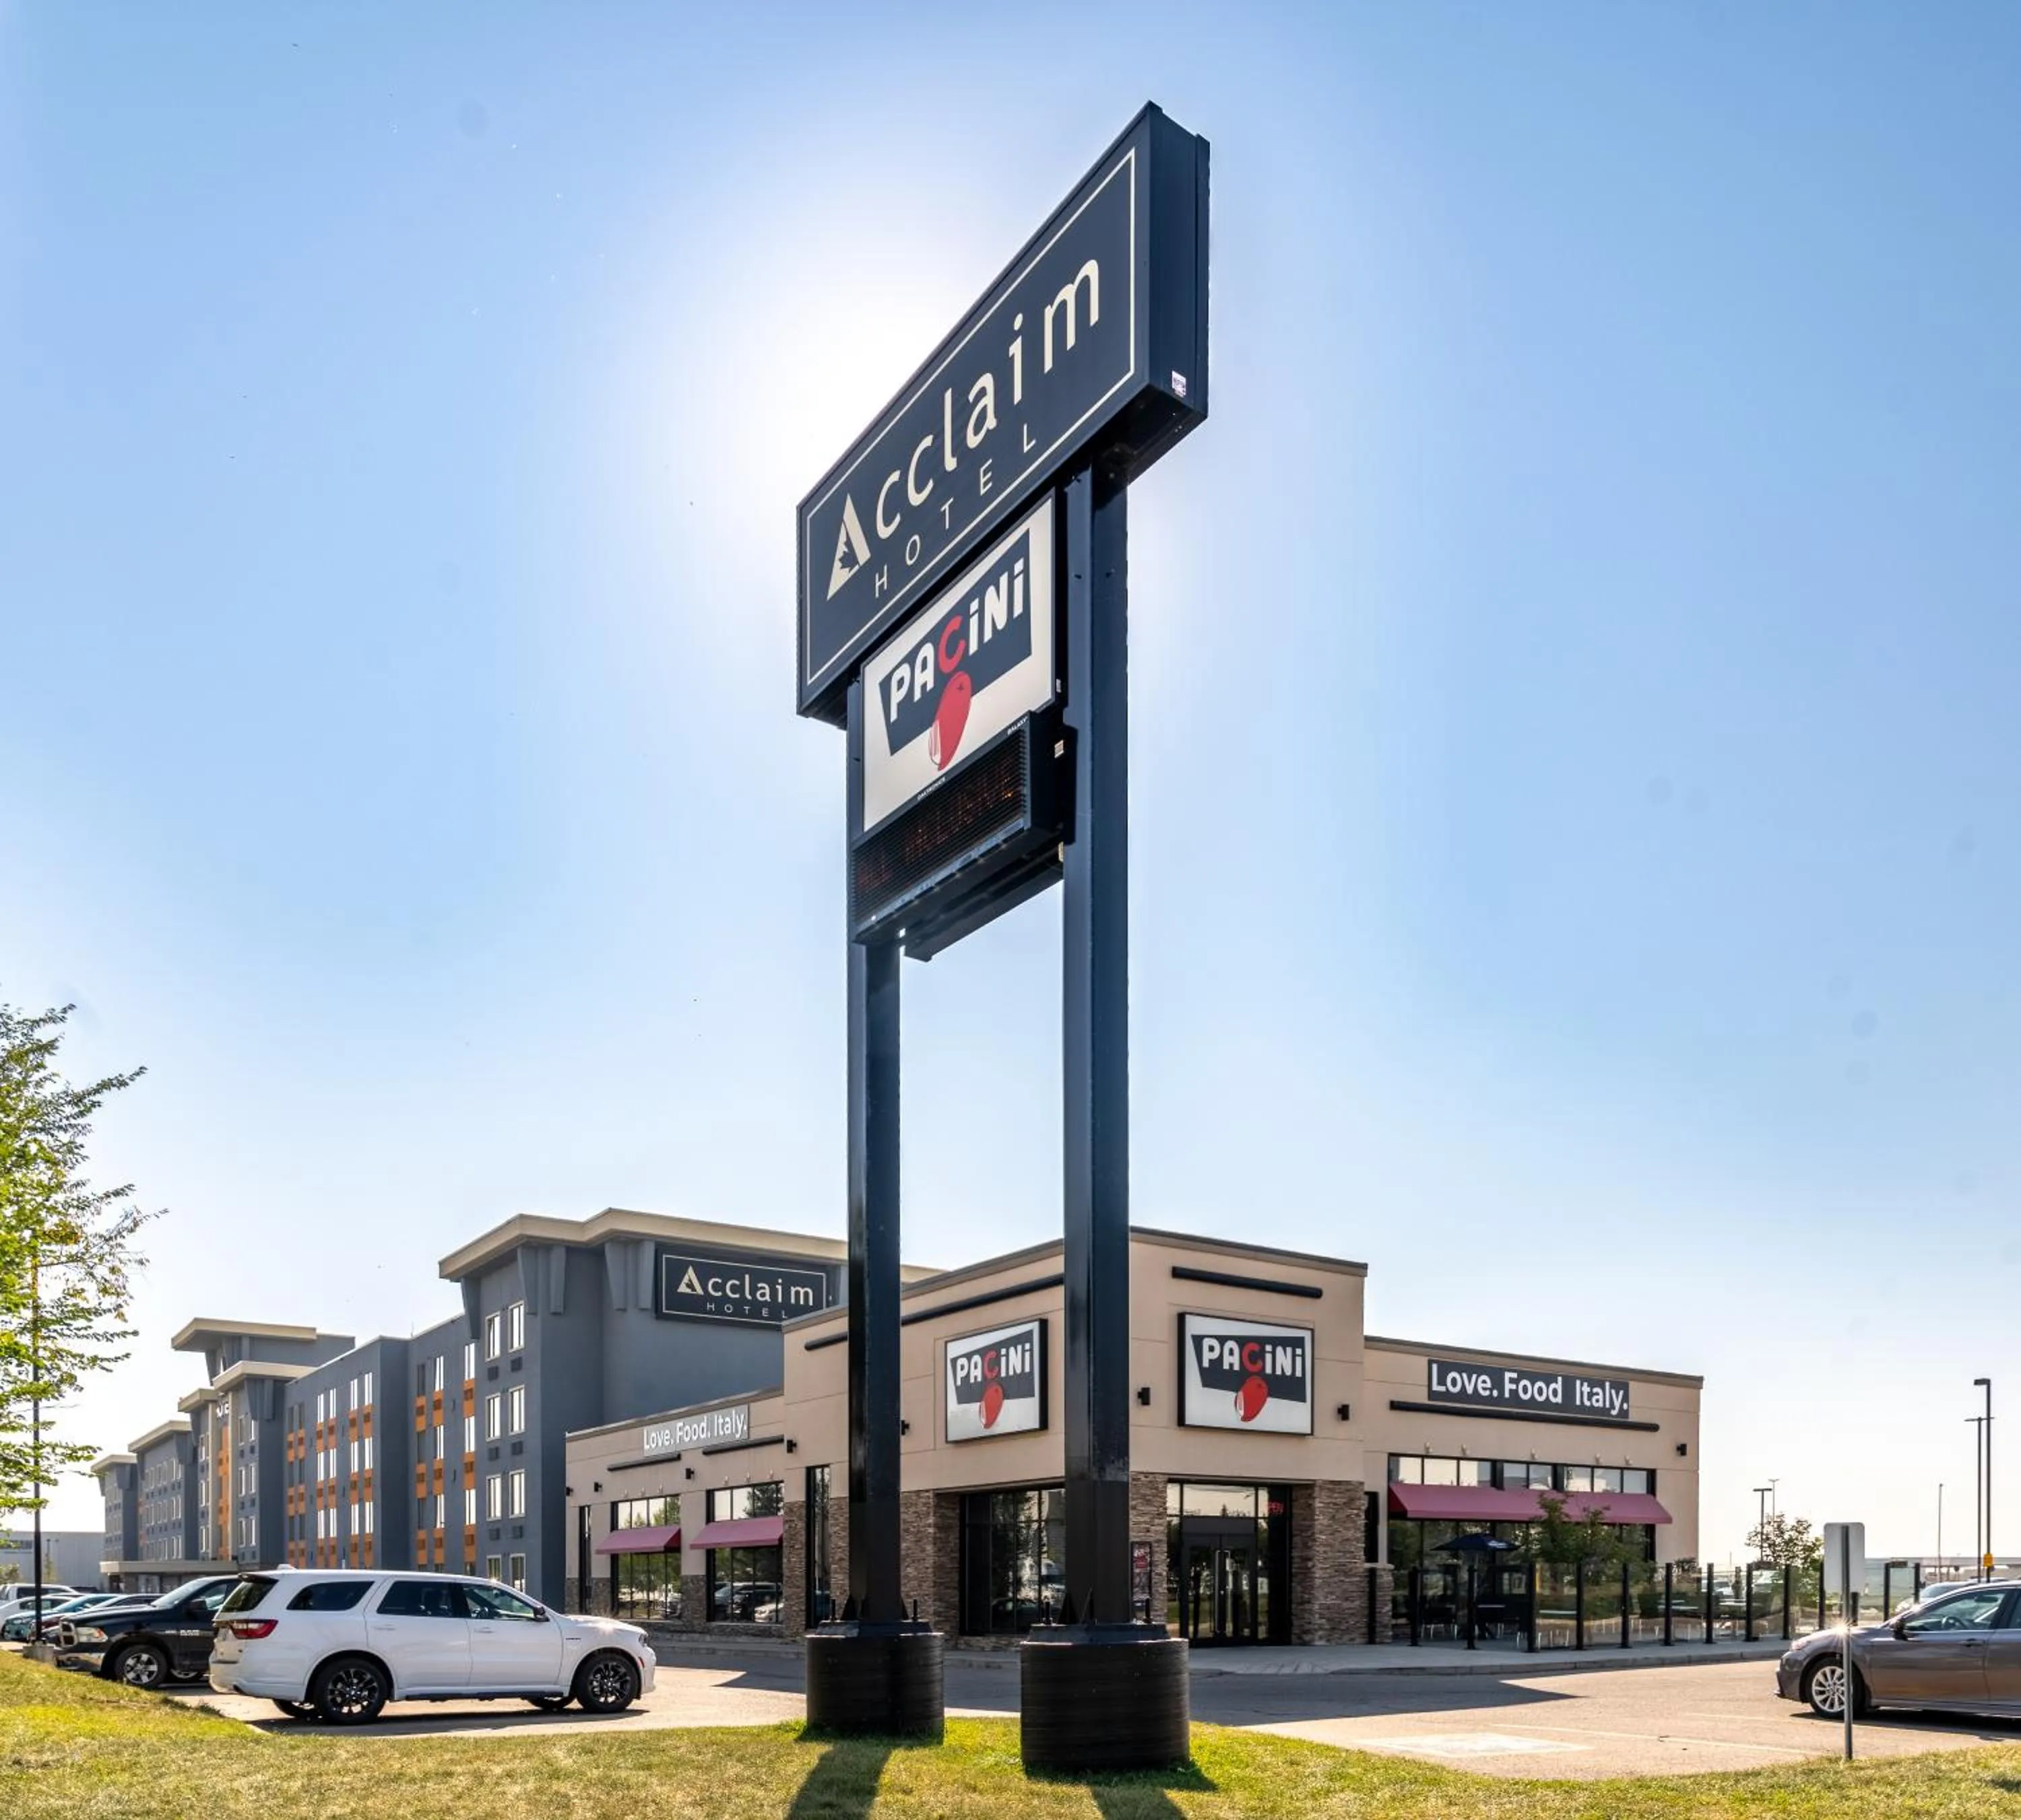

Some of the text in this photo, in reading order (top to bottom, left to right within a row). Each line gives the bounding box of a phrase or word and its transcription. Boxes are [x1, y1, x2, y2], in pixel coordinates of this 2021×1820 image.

[827, 259, 1099, 600] Acclaim
[875, 423, 1036, 598] HOTEL
[677, 1265, 813, 1306] Acclaim
[707, 1302, 788, 1318] HOTEL
[1432, 1363, 1628, 1415] Love. Food Italy.
[643, 1408, 747, 1449] Love. Food. Italy.
